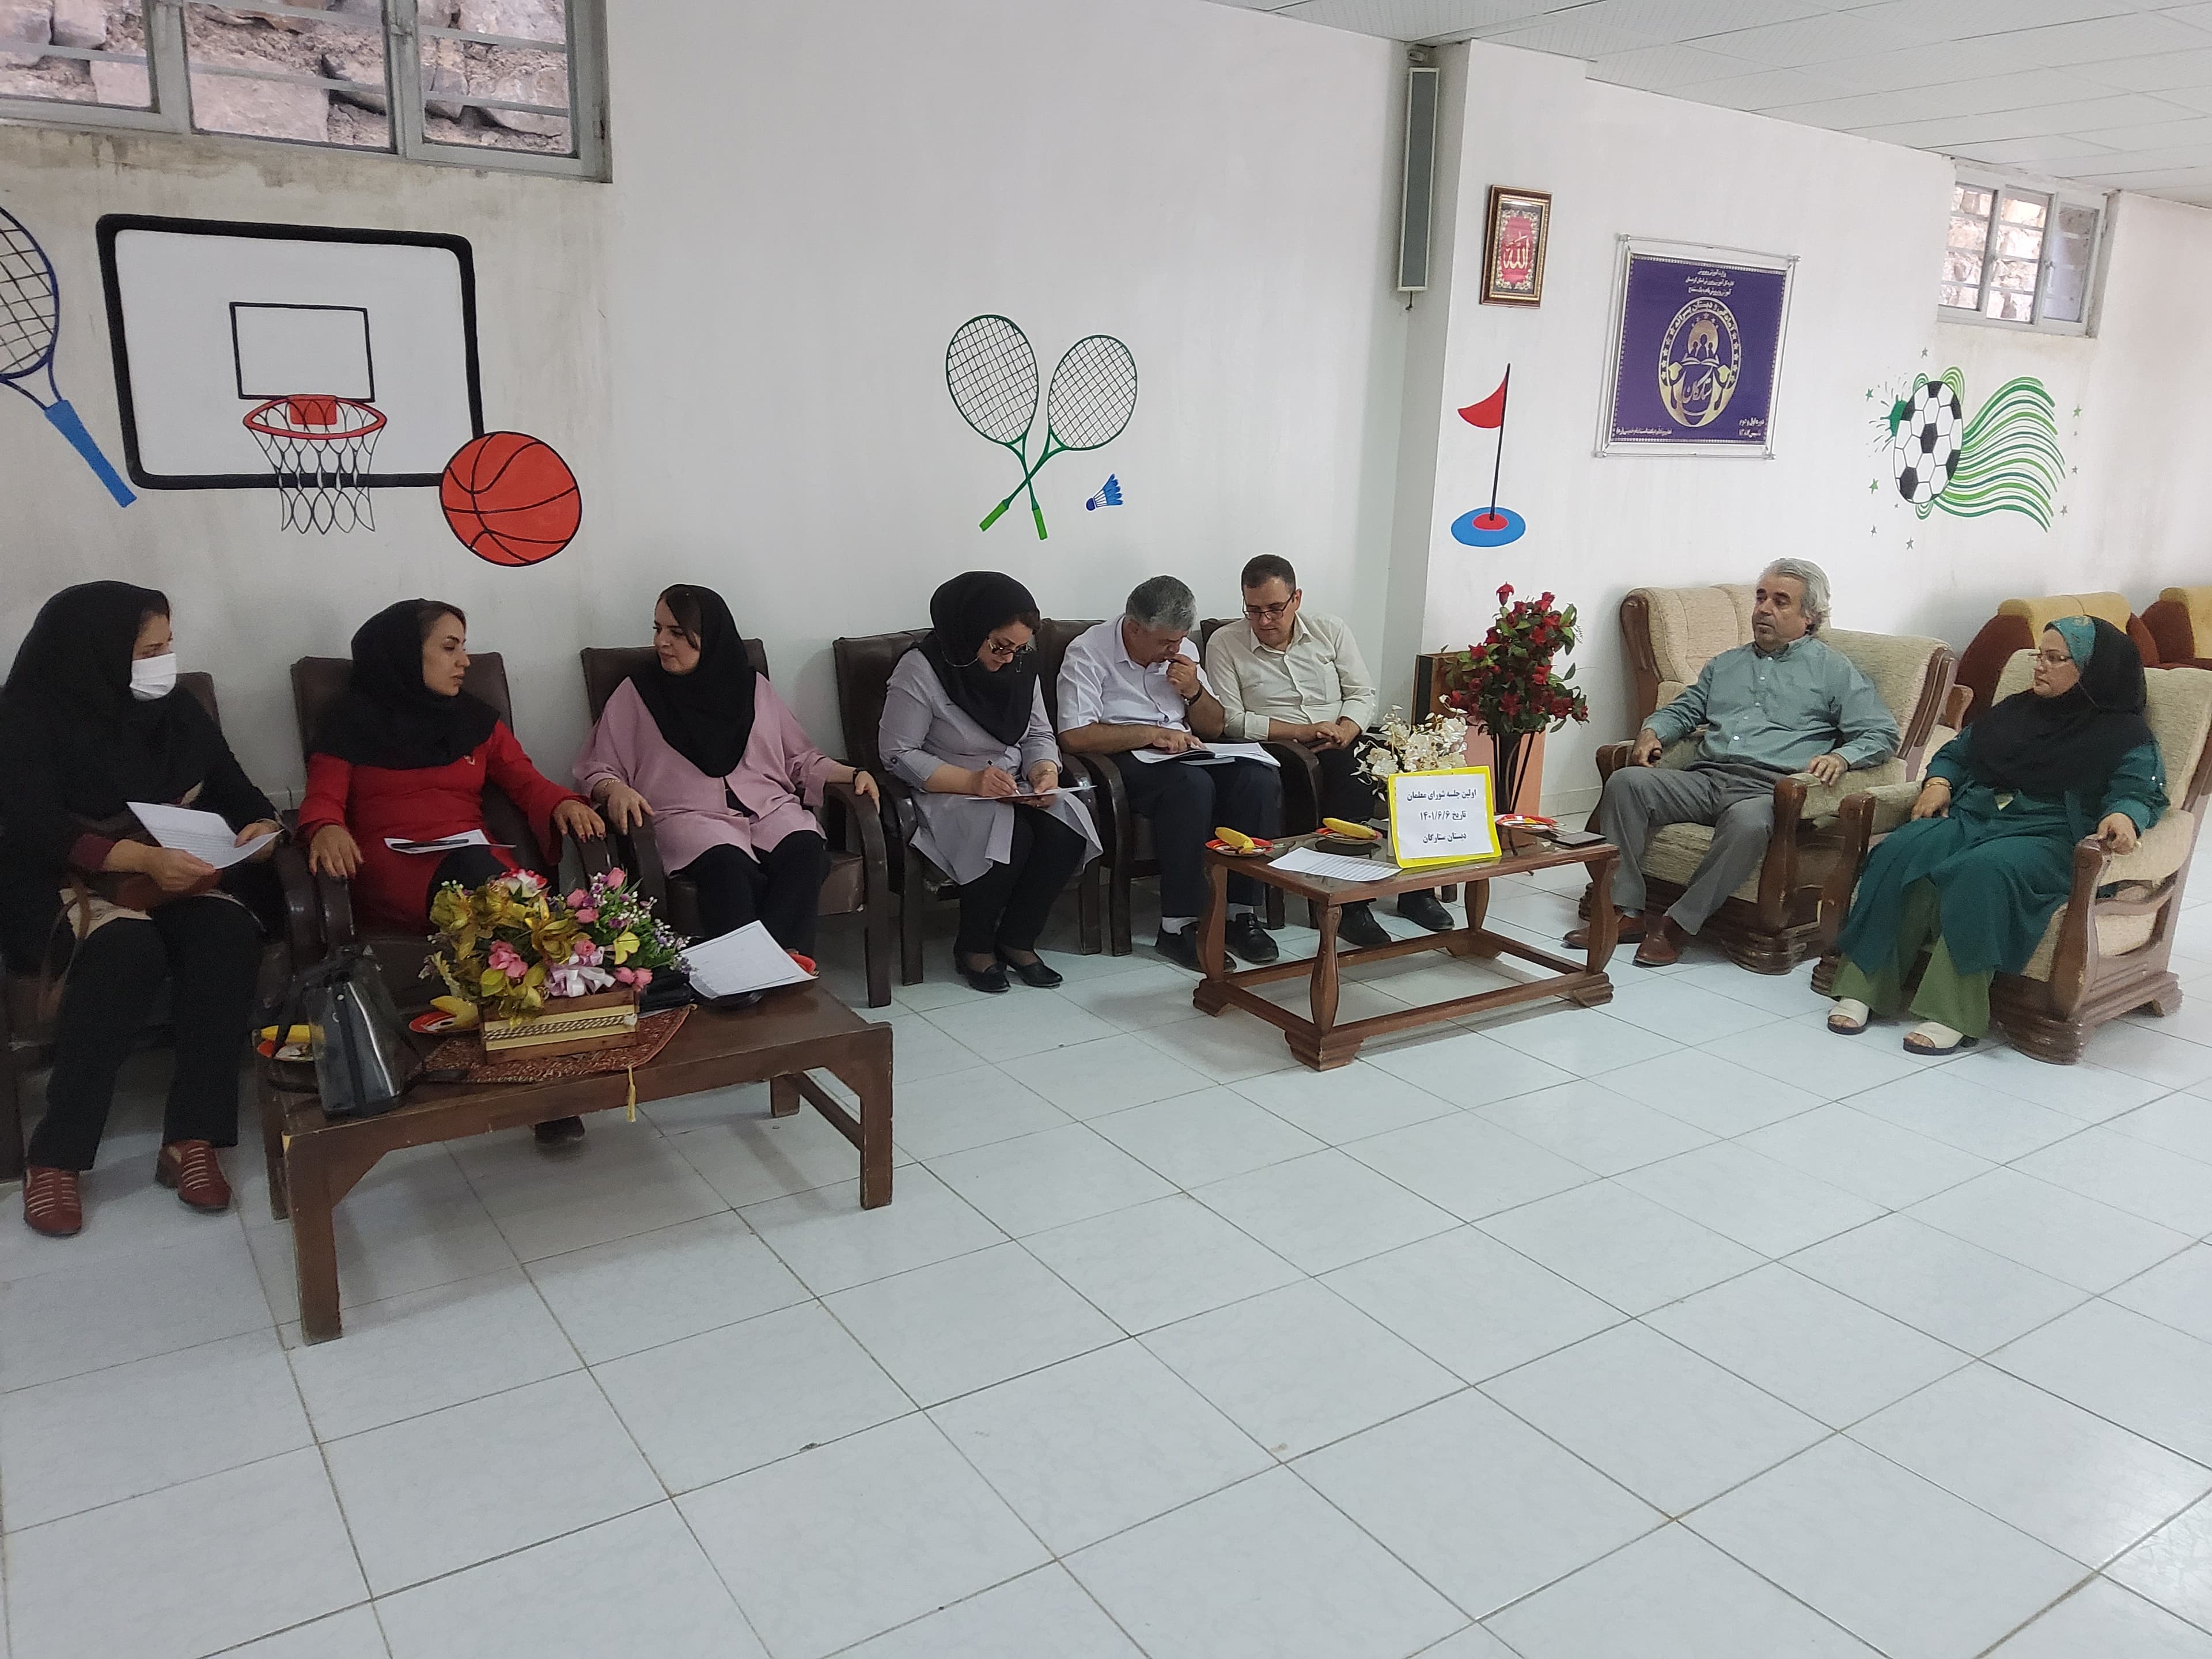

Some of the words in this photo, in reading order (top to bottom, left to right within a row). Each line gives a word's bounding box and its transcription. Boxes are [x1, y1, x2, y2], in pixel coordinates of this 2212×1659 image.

[1407, 791, 1426, 801] معلمان
[1427, 790, 1445, 801] شورای
[1446, 789, 1460, 800] جلسه
[1461, 788, 1476, 799] اولین
[1452, 810, 1467, 820] تاریخ
[1447, 832, 1467, 842] دبستان
